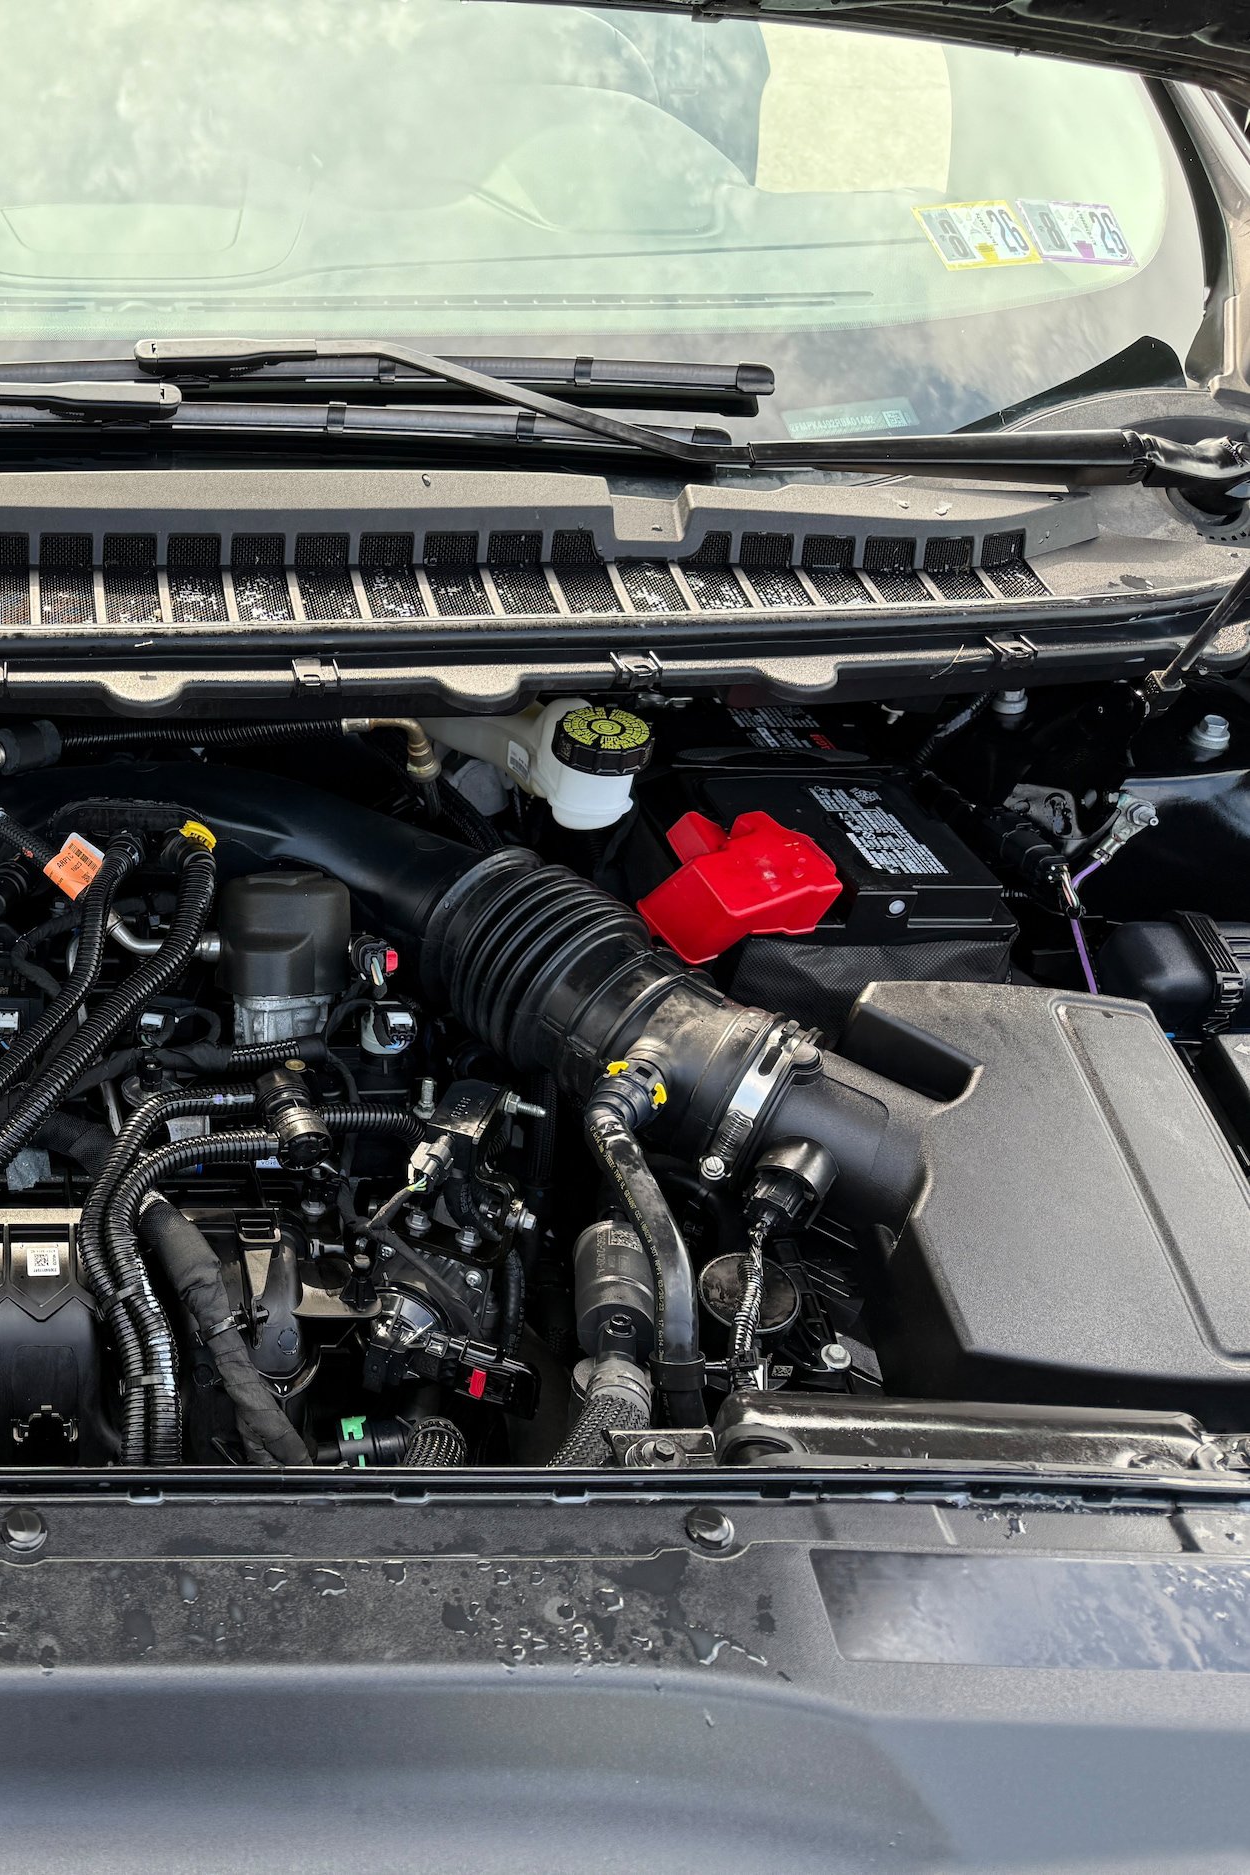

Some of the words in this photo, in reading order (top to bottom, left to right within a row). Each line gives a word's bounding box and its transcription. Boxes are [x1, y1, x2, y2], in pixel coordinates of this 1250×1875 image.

[986, 209, 1029, 252] 26
[1039, 212, 1065, 249] 8
[1089, 211, 1127, 254] 26
